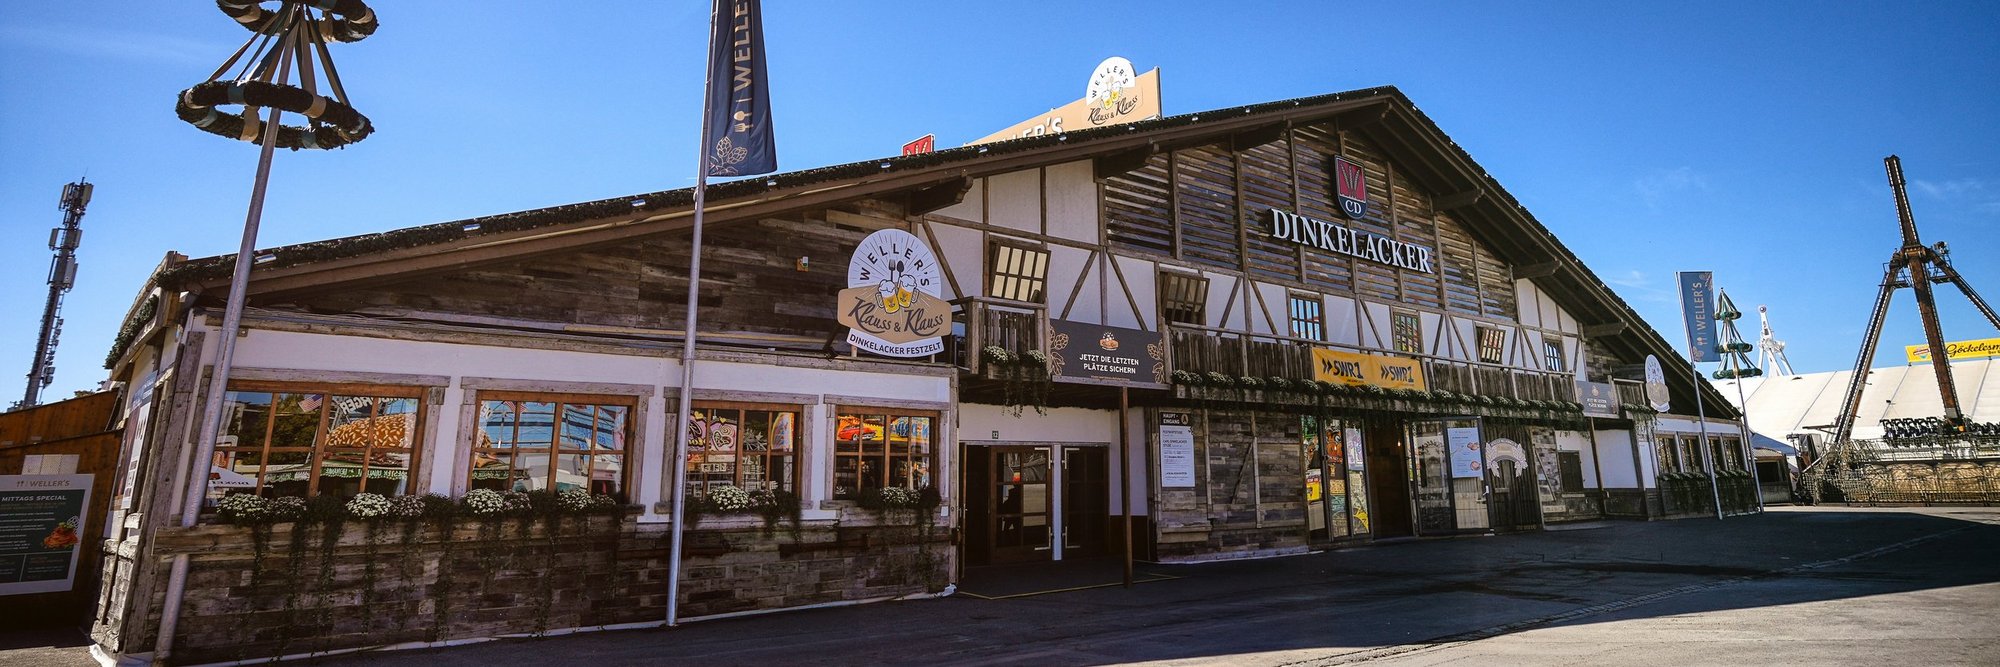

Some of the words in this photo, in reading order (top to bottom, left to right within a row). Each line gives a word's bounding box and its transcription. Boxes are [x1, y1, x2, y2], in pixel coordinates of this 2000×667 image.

[1092, 66, 1129, 98] WELLER'S
[1087, 107, 1110, 125] Klauss
[1115, 96, 1138, 117] Klauss
[1345, 200, 1362, 214] CD
[1271, 208, 1433, 274] DINKELACKER
[860, 243, 930, 287] WELLER'S
[848, 297, 892, 333] Klauss
[893, 322, 901, 332] &
[904, 308, 943, 336] Klauss
[1692, 282, 1706, 330] WELLER'S
[850, 334, 905, 354] DINKELACKER
[906, 341, 941, 354] FESTZELT
[1083, 363, 1108, 371] PLÄTZE
[1333, 360, 1364, 379] SWR1
[1389, 366, 1414, 382] SWR1
